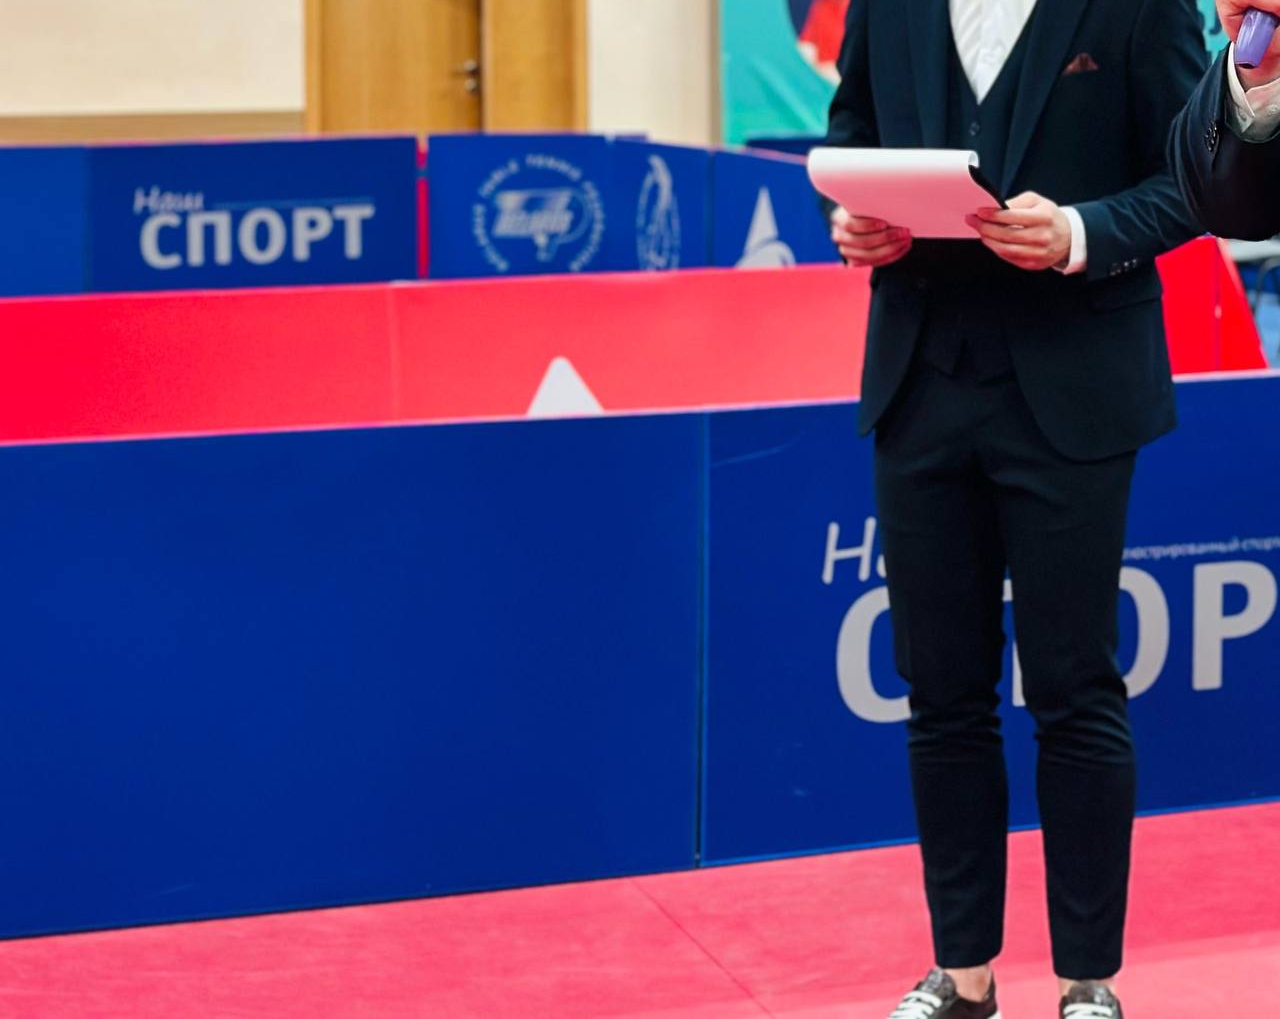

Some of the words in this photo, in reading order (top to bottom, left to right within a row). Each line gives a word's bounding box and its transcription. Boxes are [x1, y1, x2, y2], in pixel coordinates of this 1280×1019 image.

[133, 186, 204, 215] Наш
[139, 203, 376, 270] СПОРТ
[822, 515, 887, 585] Н
